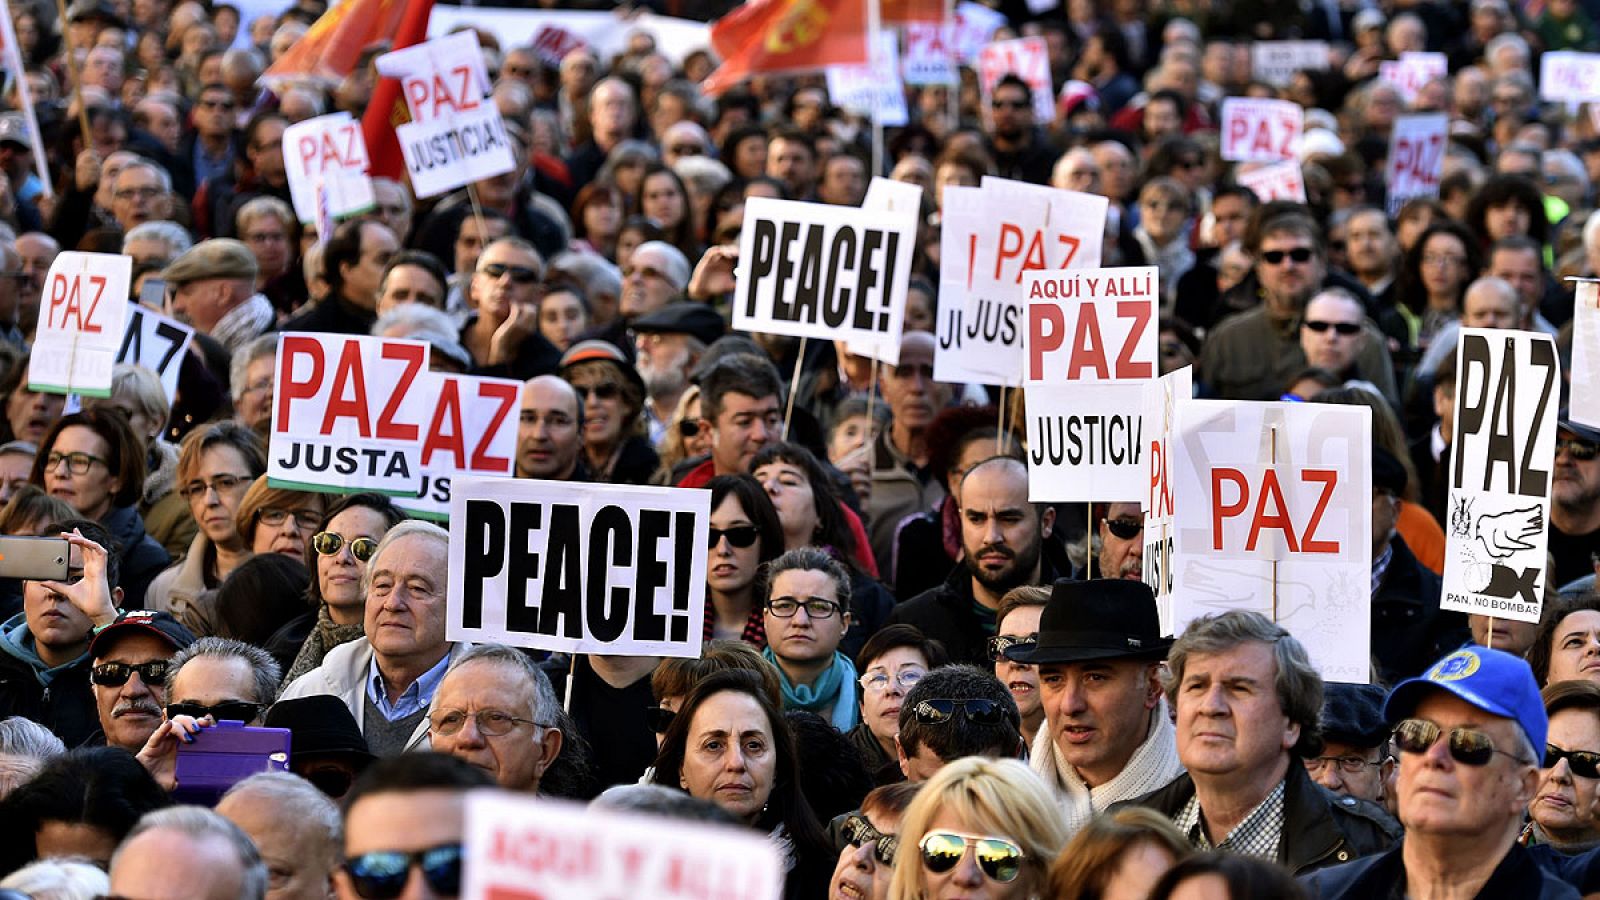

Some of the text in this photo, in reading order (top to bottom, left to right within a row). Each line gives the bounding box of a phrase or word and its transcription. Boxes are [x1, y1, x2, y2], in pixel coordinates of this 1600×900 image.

[407, 65, 480, 123] PAZ
[298, 124, 362, 177] PAZ
[409, 116, 505, 173] JUSTICIA!
[1227, 115, 1298, 159] PAZ
[1389, 132, 1443, 190] PAZ
[47, 273, 107, 333] PAZ
[746, 219, 900, 332] PEACE!
[1030, 272, 1151, 298] AQUÍ Y ALLÍ
[115, 310, 188, 377] AZ
[967, 299, 1024, 351] JUS
[1029, 300, 1152, 381] PAZ
[276, 335, 425, 441] PAZ
[1454, 335, 1556, 498] PAZ
[420, 377, 518, 472] AZ
[278, 442, 411, 479] JUSTA
[1150, 437, 1174, 520] PA
[1211, 467, 1340, 553] PAZ
[462, 499, 697, 643] PEACE!
[1446, 592, 1539, 616] PAN, NO BOMBAS
